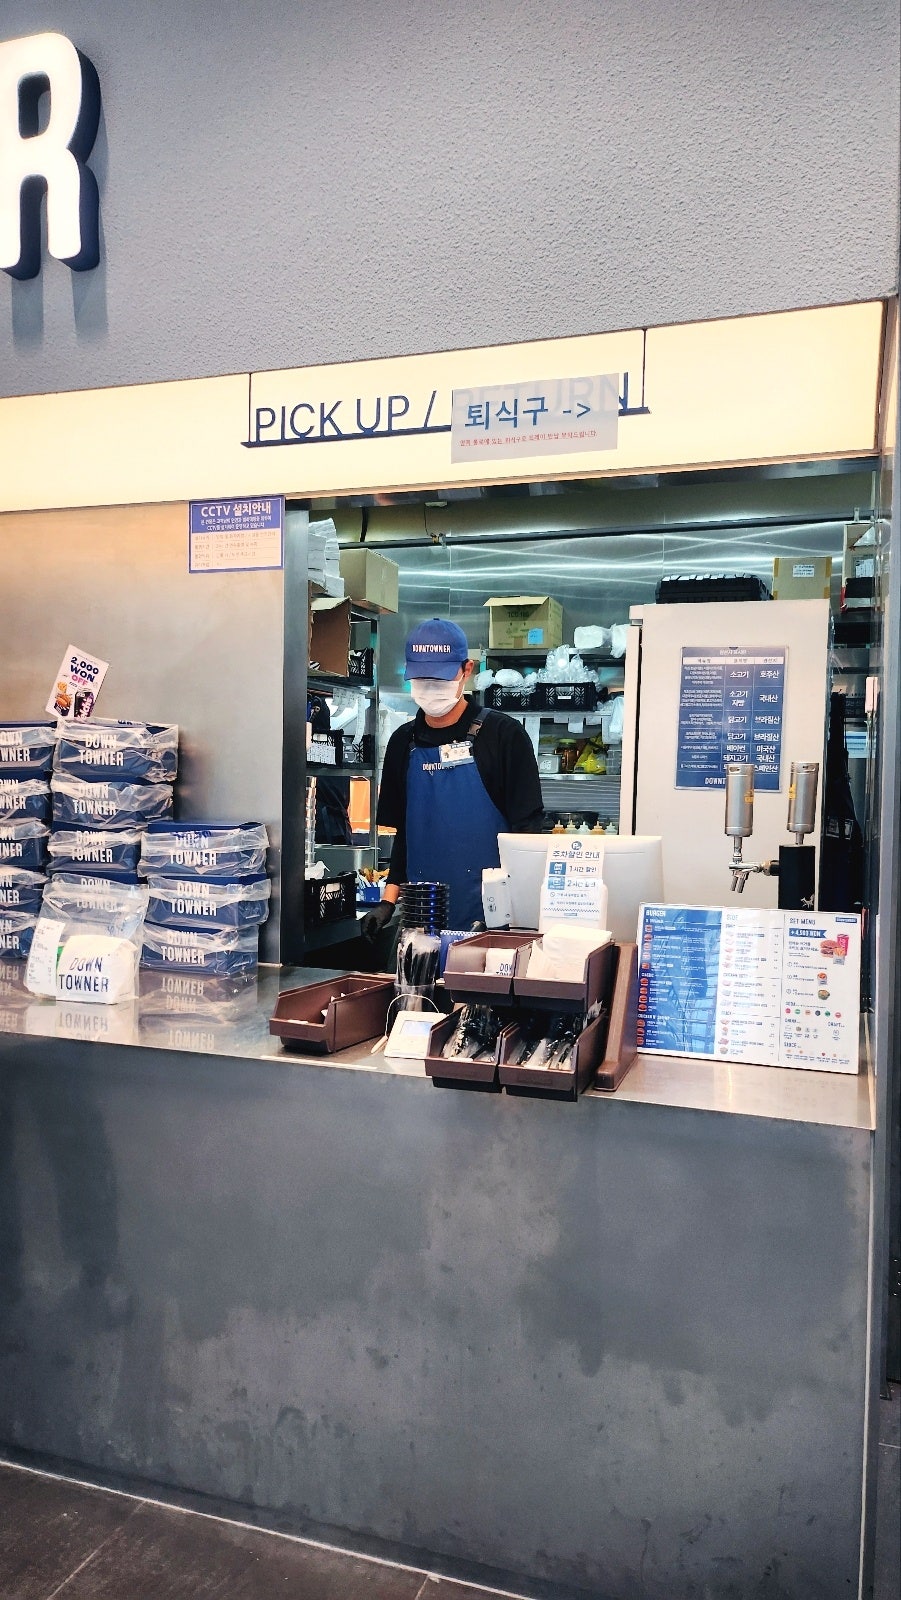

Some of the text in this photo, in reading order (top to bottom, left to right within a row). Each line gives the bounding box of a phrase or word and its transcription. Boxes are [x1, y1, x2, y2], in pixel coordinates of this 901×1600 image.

[256, 402, 342, 441] PICK
[356, 395, 409, 433] UP
[465, 397, 548, 430] 퇴식구
[201, 501, 271, 517] CCTV 설치안내
[70, 656, 99, 674] 2,000
[70, 664, 95, 682] WON
[72, 675, 88, 685] OFF
[730, 670, 749, 678] 소고기
[760, 670, 779, 679] 호주산
[730, 690, 748, 698] 소고기
[759, 694, 778, 703] 국내산
[85, 733, 117, 749] DOWN
[756, 744, 776, 754] 미국산
[79, 750, 124, 767] TOWNER
[756, 754, 775, 763] 국내산
[705, 777, 726, 785] DOWNT
[79, 783, 109, 799] DOWN
[73, 799, 118, 816] TOWNER
[174, 831, 210, 849] DOWN
[71, 848, 113, 864] TOWNER
[169, 851, 217, 866] TOWNER
[585, 851, 600, 859] 안내
[177, 882, 210, 897] DOWN
[171, 899, 217, 917] TOWNER
[166, 930, 199, 948] DOWN
[161, 946, 205, 965] TOWNER
[70, 957, 103, 973] DOWN
[58, 974, 109, 993] TOWNER
